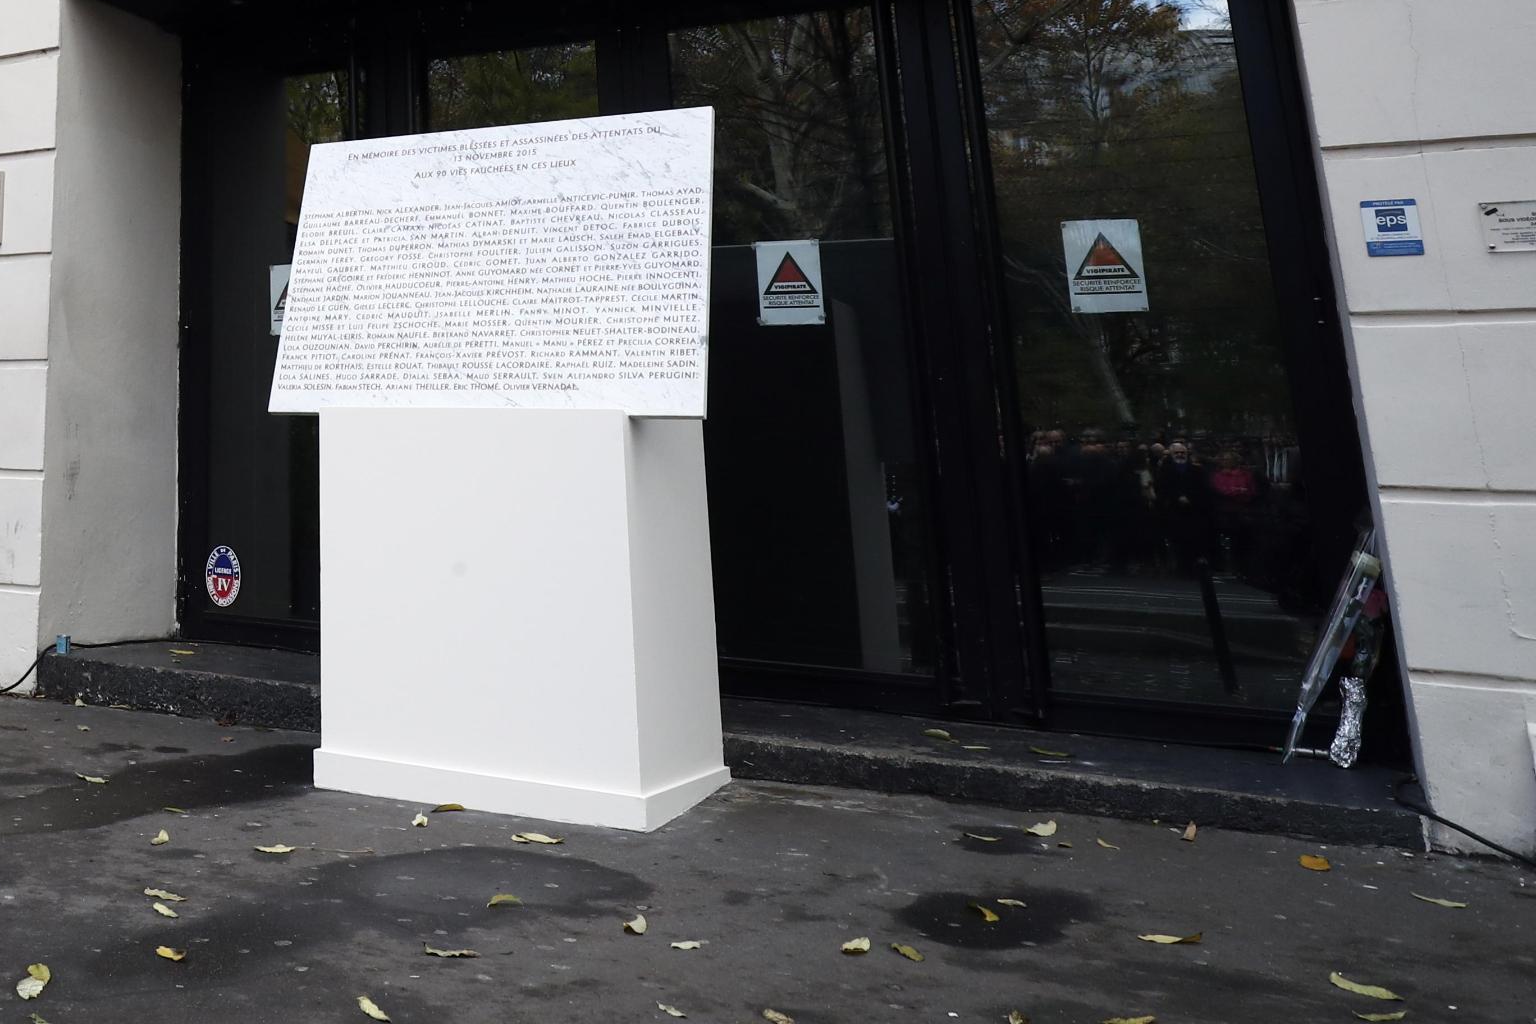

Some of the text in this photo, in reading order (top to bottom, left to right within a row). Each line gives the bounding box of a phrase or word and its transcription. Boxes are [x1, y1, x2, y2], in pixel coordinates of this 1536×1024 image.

[418, 144, 457, 154] VICTIMES
[511, 134, 569, 145] ASSASSINÉES
[571, 132, 588, 140] DES
[590, 127, 643, 138] ATTENTATS
[464, 150, 513, 160] NOVEMBRE
[516, 148, 537, 156] 2015
[469, 164, 514, 174] FAUCHÉES
[530, 161, 547, 169] CES
[549, 159, 576, 168] LIEUX
[1376, 214, 1407, 228] eps
[217, 578, 231, 592] IV
